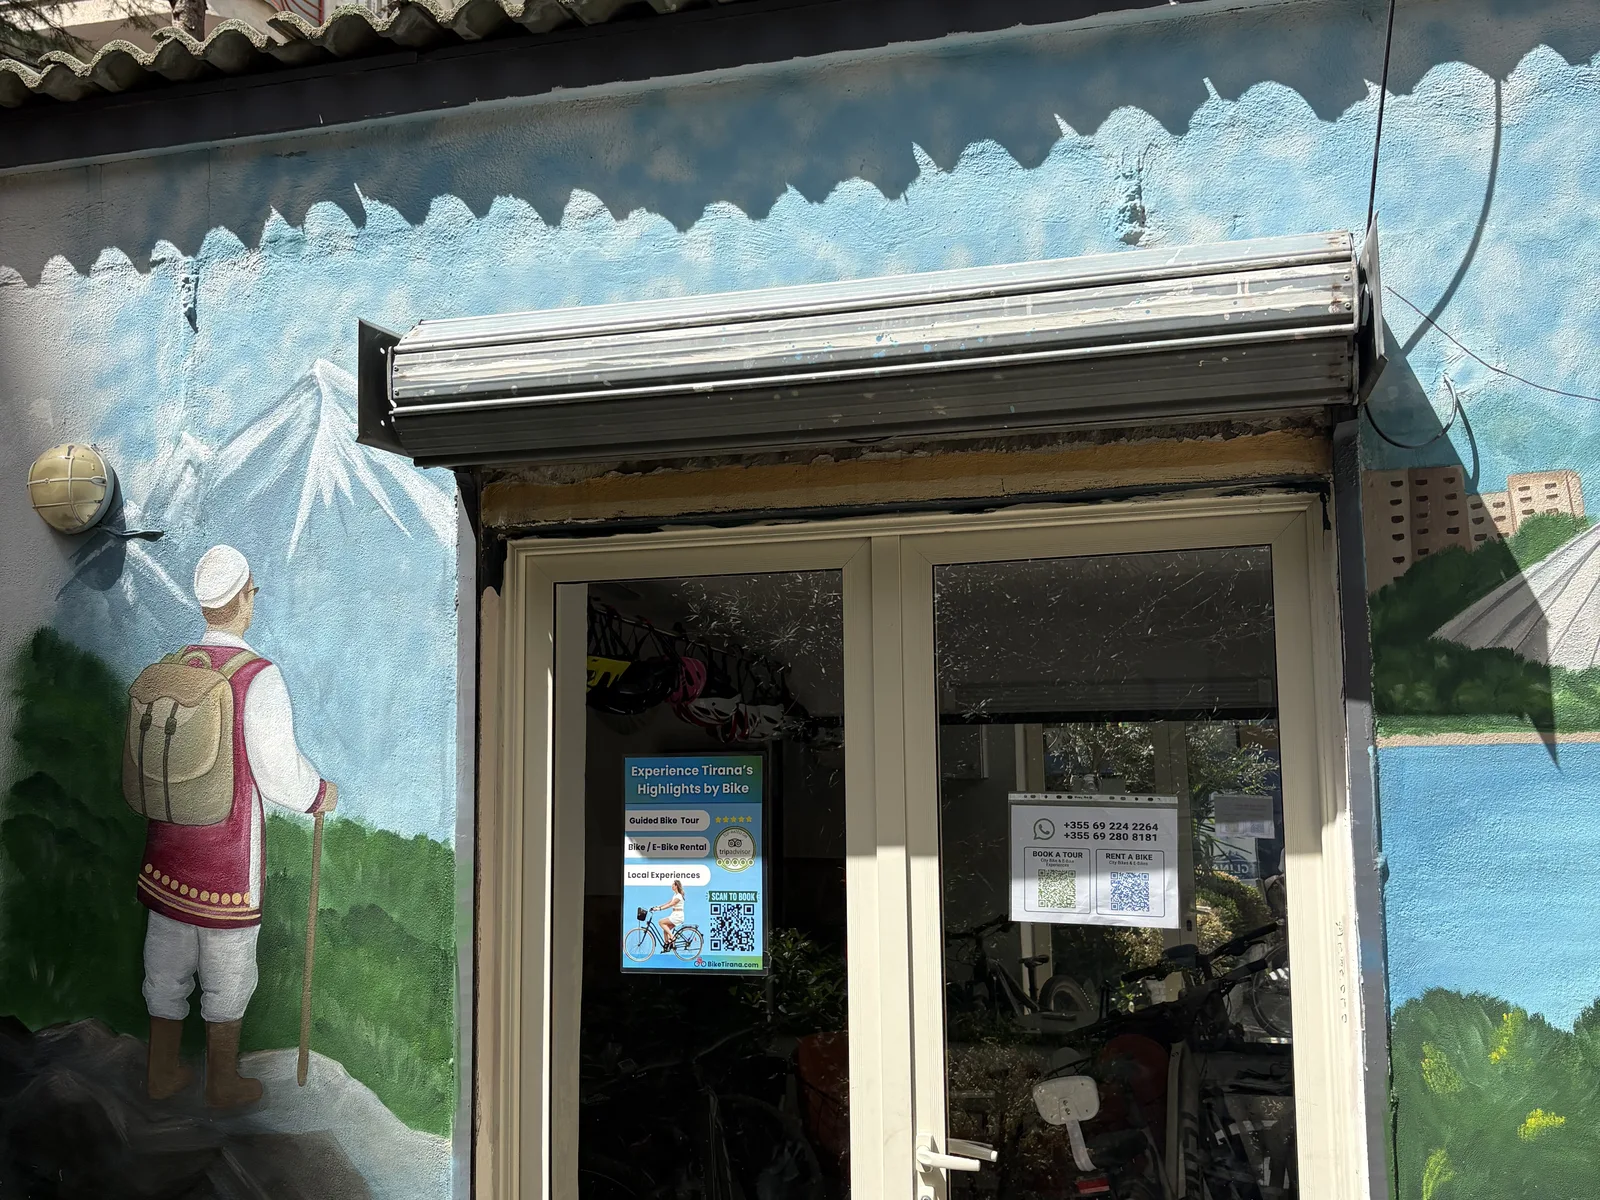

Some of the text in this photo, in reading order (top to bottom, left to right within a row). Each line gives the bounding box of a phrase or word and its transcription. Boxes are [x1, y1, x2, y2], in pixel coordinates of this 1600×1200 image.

[631, 764, 754, 779] Experience Tirana’s
[637, 782, 749, 797] Highlights by Bike
[629, 817, 699, 825] Guided Bike Tour
[1064, 821, 1159, 831] +355 69 224 2264
[1064, 832, 1158, 841] +355 69 280 8181
[628, 843, 646, 851] Bike
[652, 843, 678, 851] E-Bike
[680, 843, 707, 851] Rental
[628, 871, 700, 880] Local Experiences
[712, 893, 755, 901] SCAN TO BOOK
